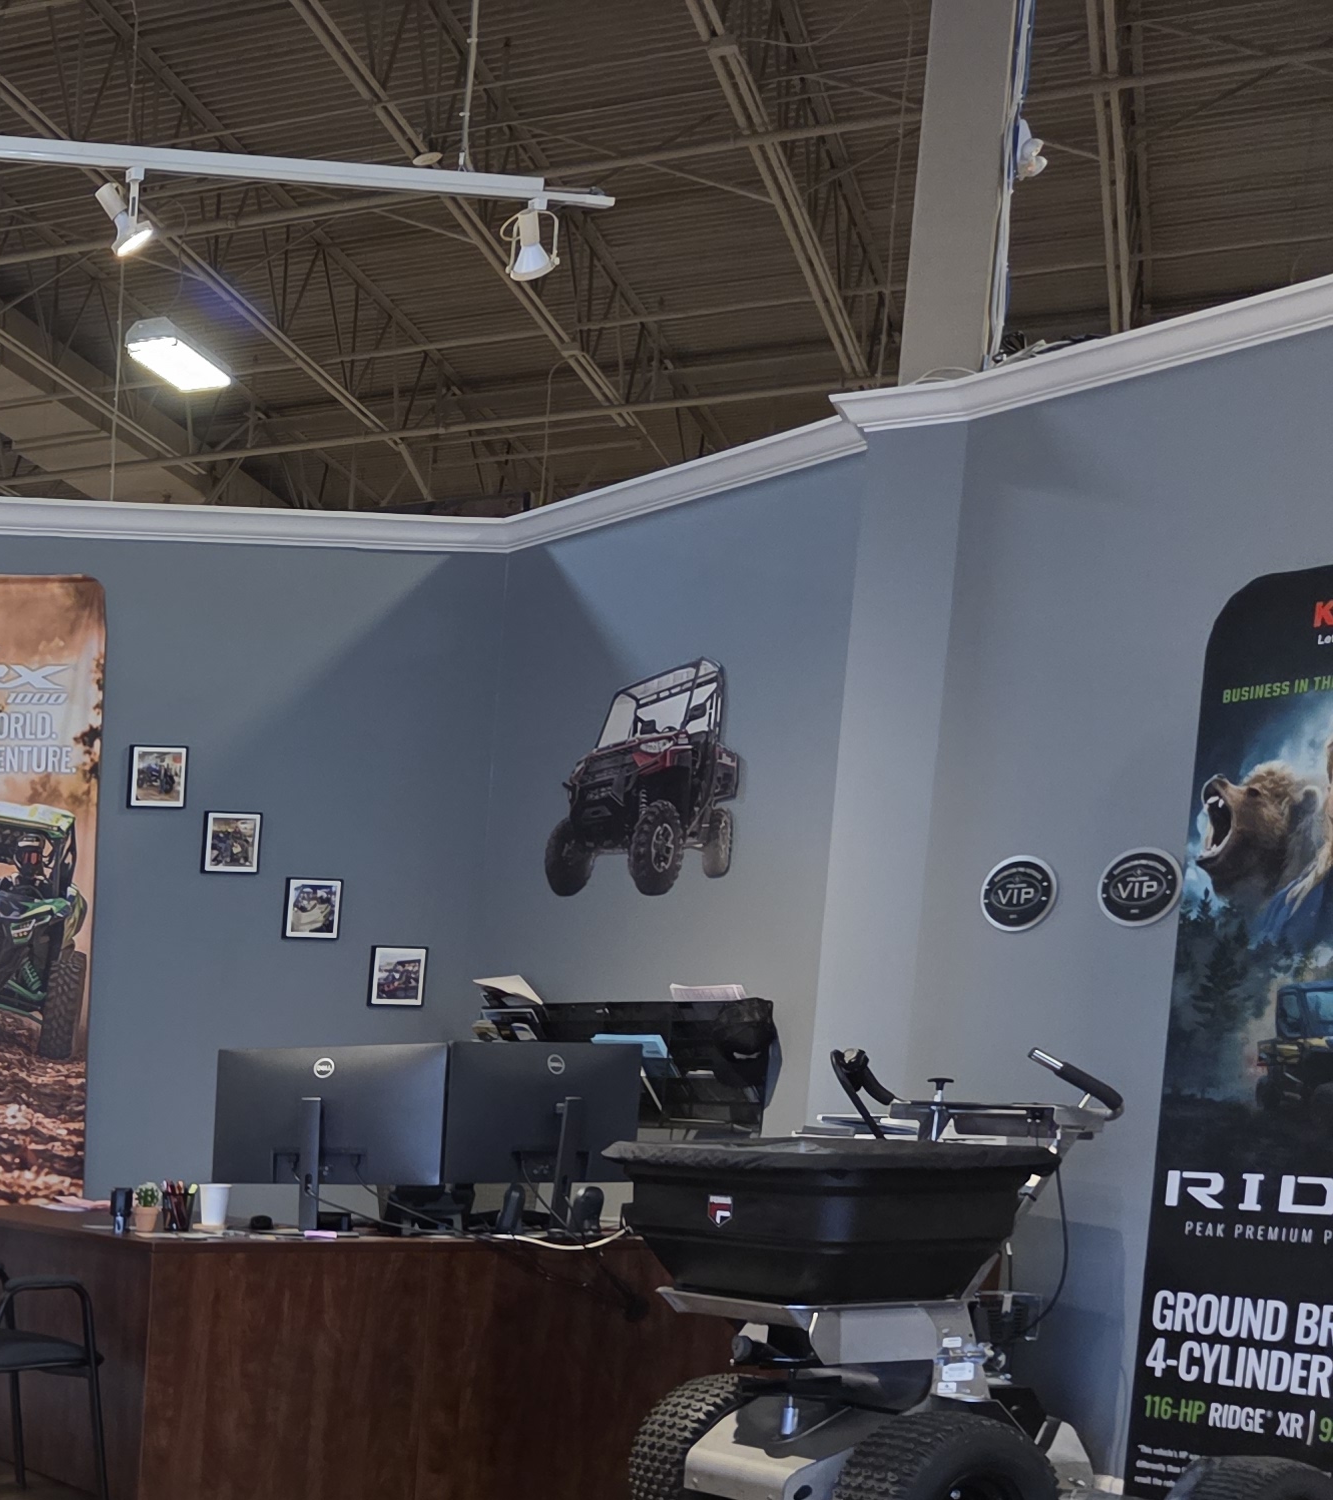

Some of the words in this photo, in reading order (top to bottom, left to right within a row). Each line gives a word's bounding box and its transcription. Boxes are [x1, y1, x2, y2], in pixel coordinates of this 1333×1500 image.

[7, 692, 68, 705] 1000
[1222, 681, 1290, 703] BUSINESS
[1294, 678, 1309, 693] IN
[1314, 675, 1333, 691] TH
[997, 888, 1035, 905] VIP
[1118, 881, 1158, 899] VIP
[1185, 1220, 1225, 1238] PEAK
[1234, 1224, 1313, 1244] PREMIUM
[1152, 1289, 1288, 1342] GROUND
[1145, 1337, 1333, 1399] 4-CYLINDER
[1144, 1394, 1207, 1424] 116-HP
[1276, 1410, 1305, 1440] XR
